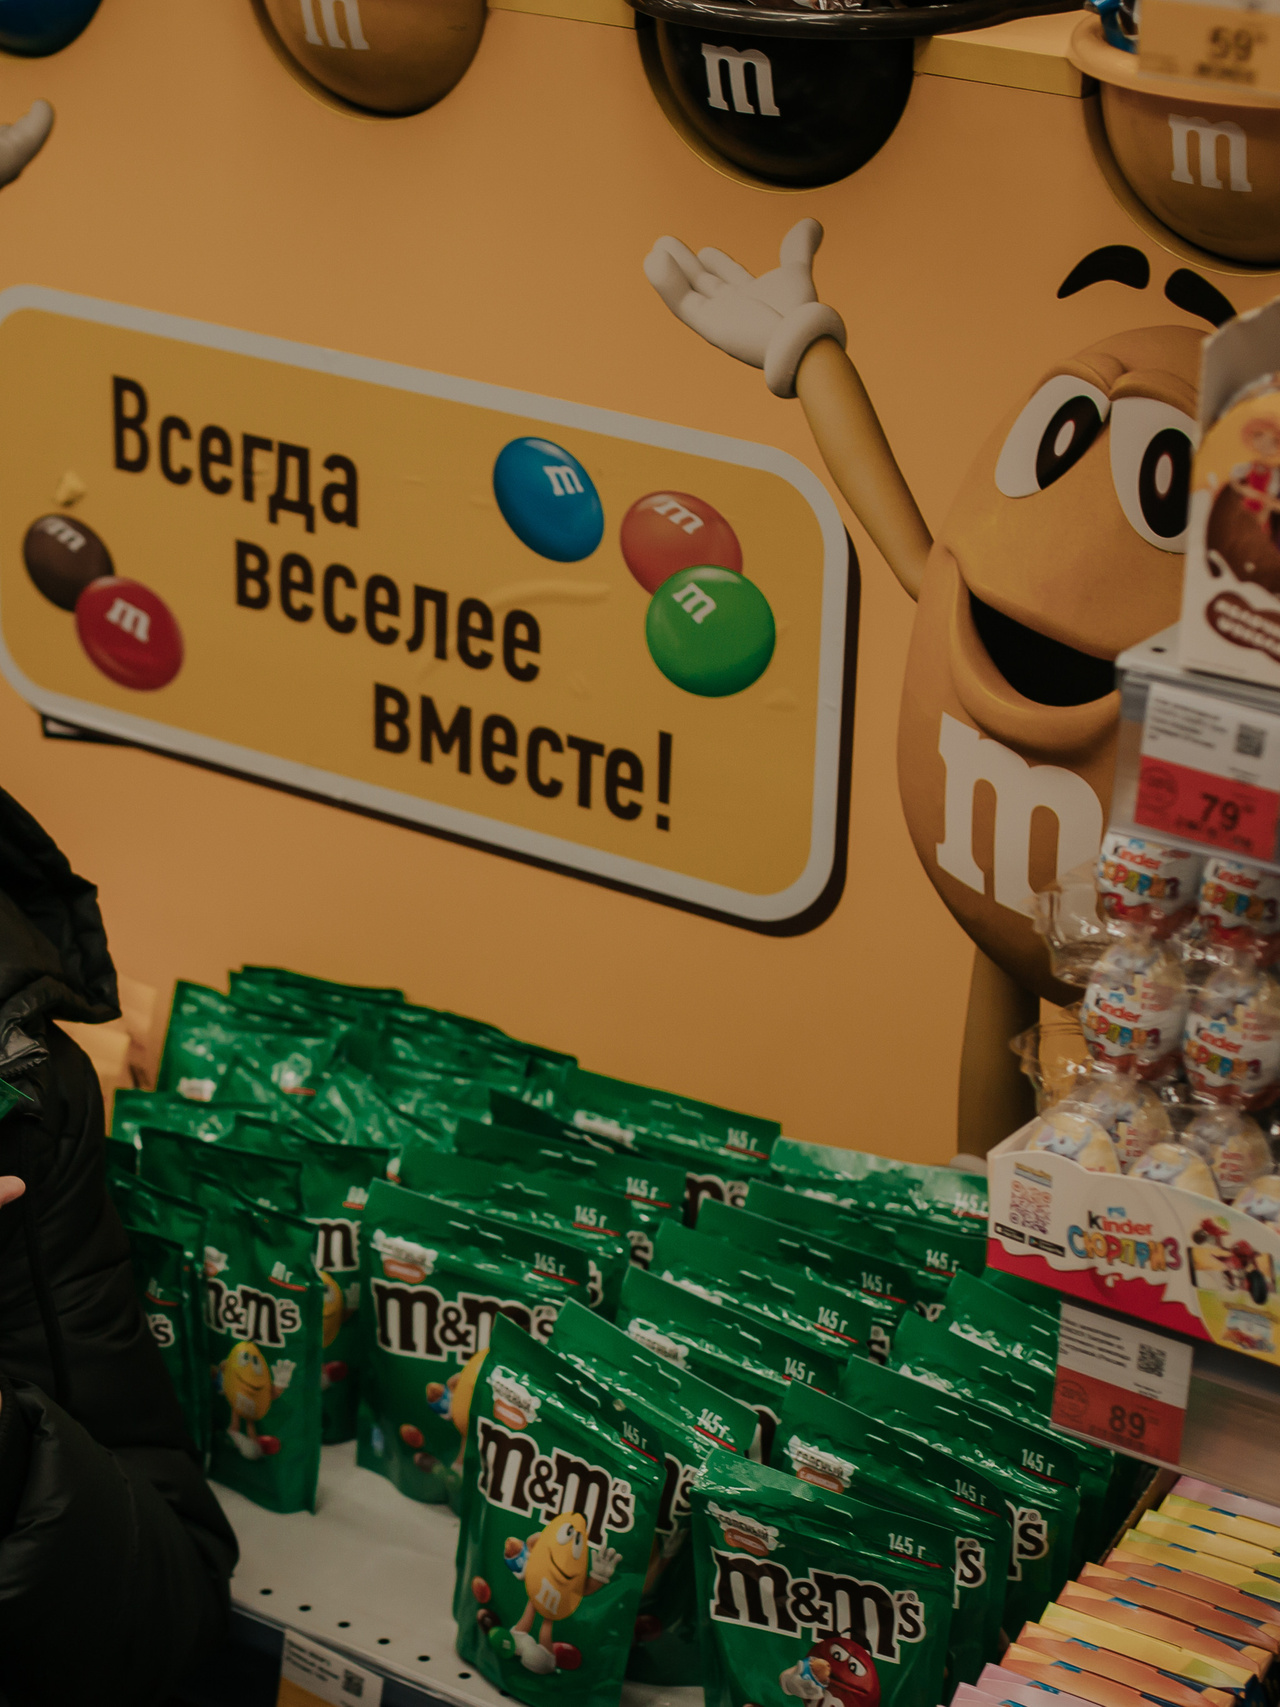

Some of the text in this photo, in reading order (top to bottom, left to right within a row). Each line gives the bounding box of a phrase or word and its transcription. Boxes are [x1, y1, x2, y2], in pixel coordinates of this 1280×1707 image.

[701, 43, 780, 117] m
[1168, 113, 1252, 192] m
[111, 374, 359, 534] Всегда
[234, 538, 541, 683] веселее
[373, 682, 673, 832] вместе!
[1203, 792, 1240, 831] 79
[626, 1177, 649, 1197] 145
[575, 1205, 597, 1227] 145
[926, 1249, 949, 1270] 145
[861, 1271, 883, 1293] 145
[818, 1306, 839, 1330] 145
[784, 1357, 806, 1381] 145
[622, 1421, 639, 1444] 145
[1108, 1404, 1146, 1439] 89
[1021, 1448, 1046, 1473] 145
[955, 1478, 978, 1502] 145
[888, 1532, 914, 1555] 145
